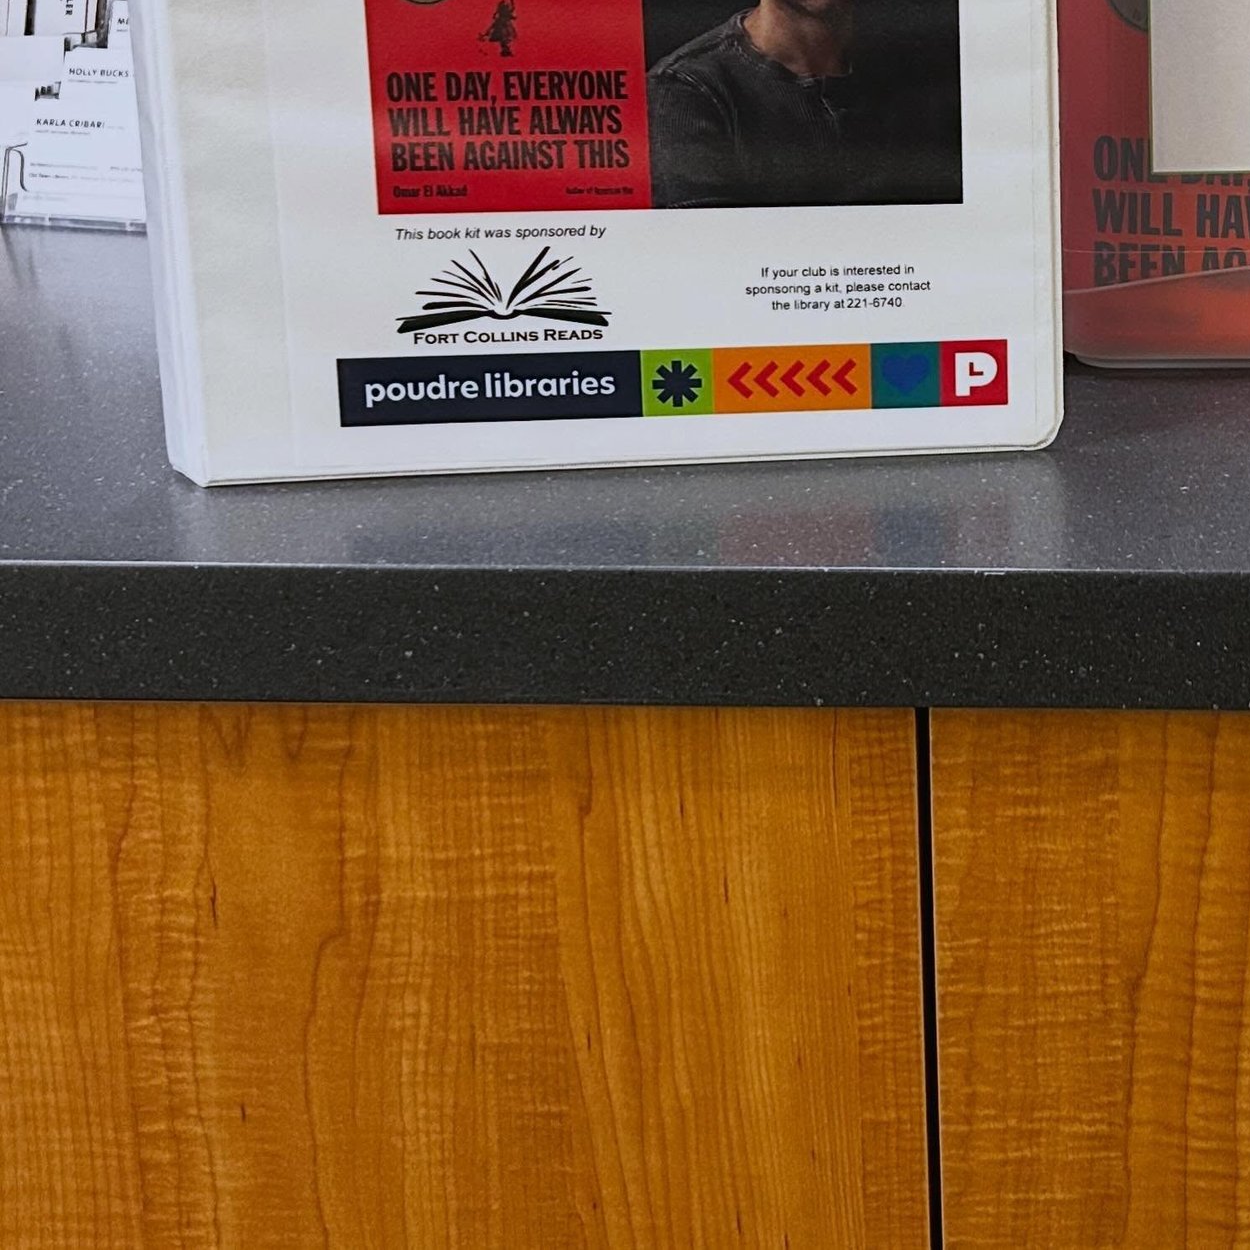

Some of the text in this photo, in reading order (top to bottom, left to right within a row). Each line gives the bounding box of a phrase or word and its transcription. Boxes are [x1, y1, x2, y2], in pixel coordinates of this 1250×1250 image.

[68, 67, 98, 77] HOLLY
[387, 70, 629, 105] ONE DAY, EVERYONE
[36, 118, 66, 127] KARLA
[388, 104, 623, 137] WILL HAVE ALWAYS
[391, 139, 630, 171] BEEN AGAINST THIS
[1092, 188, 1183, 237] WILL
[396, 225, 606, 240] This book kit was sponsored by
[761, 264, 914, 280] If your club is interested in
[1094, 241, 1185, 287] BEEN
[745, 284, 811, 297] sponsoring
[814, 285, 822, 294] a
[846, 281, 884, 295] please
[888, 280, 931, 292] contact
[772, 299, 790, 310] the
[794, 299, 830, 312] library
[834, 299, 845, 309] at
[413, 328, 604, 345] FORT COLLINS READS
[484, 369, 615, 398] libraries
